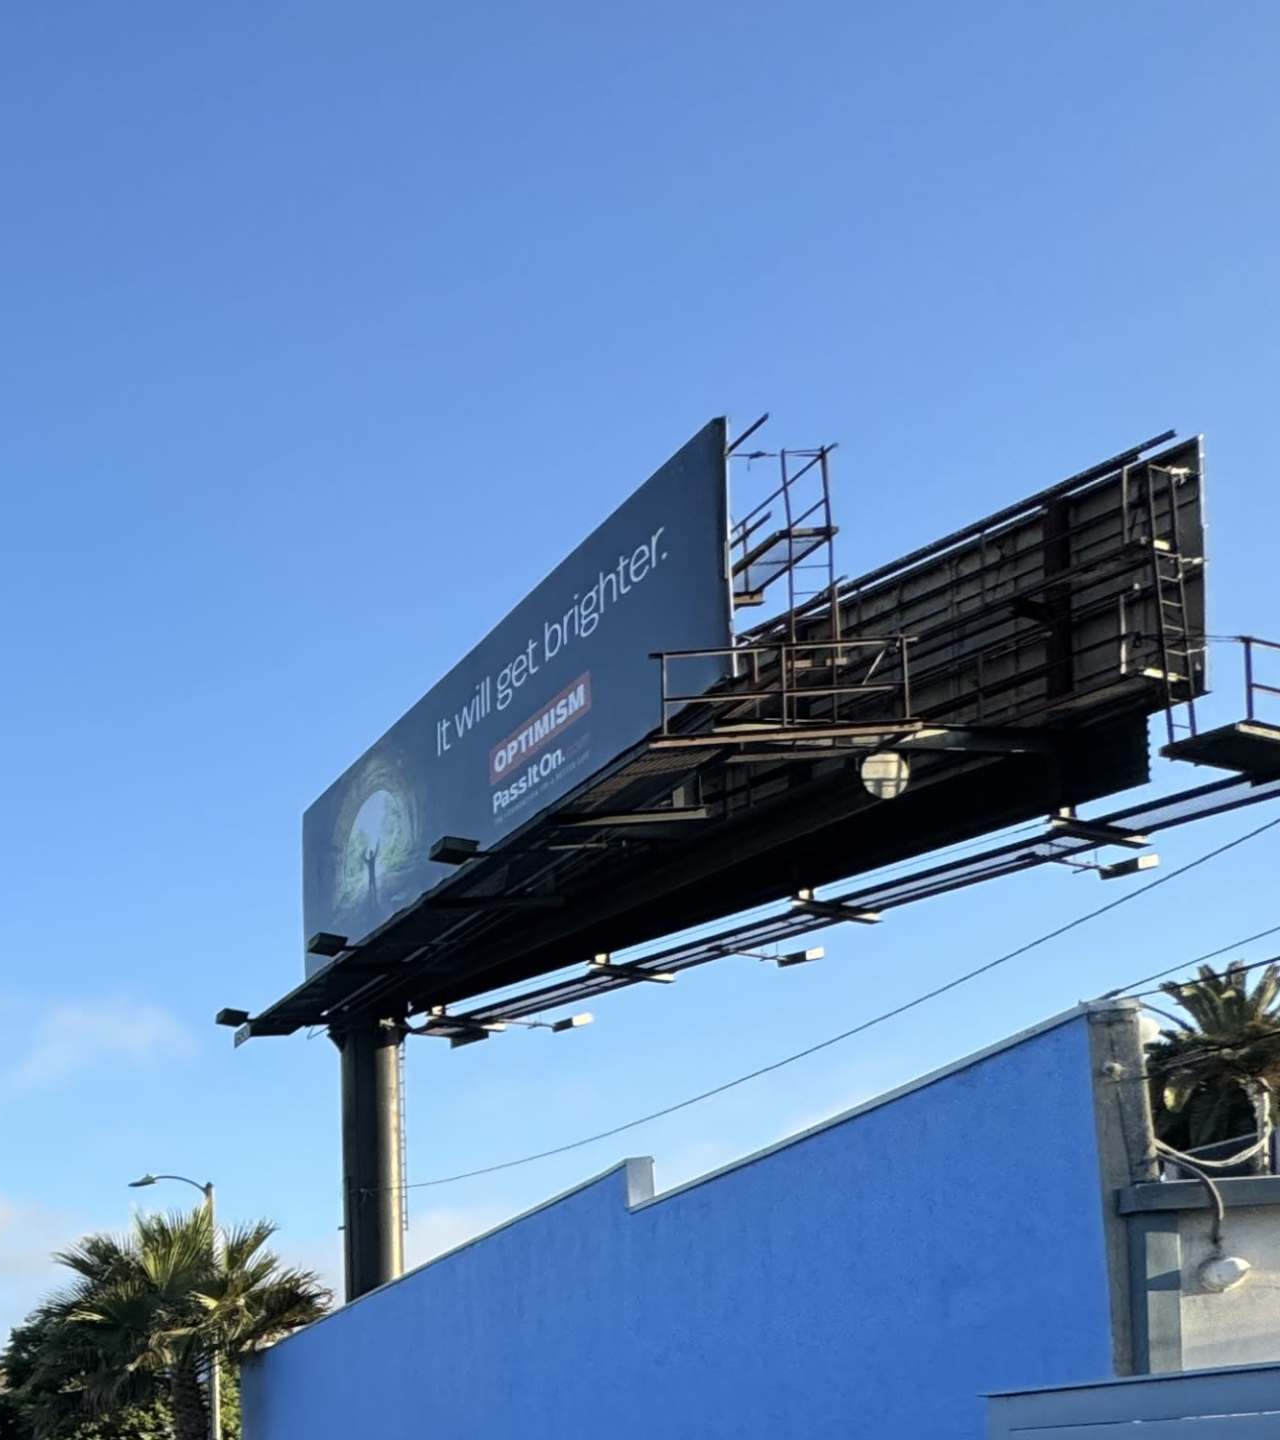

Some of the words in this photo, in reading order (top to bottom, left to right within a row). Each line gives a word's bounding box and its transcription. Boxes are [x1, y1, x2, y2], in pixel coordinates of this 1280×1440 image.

[436, 718, 452, 757] It
[454, 676, 491, 738] will
[496, 639, 539, 710] get
[544, 526, 669, 662] brighter.
[494, 684, 585, 773] OPTIMISM
